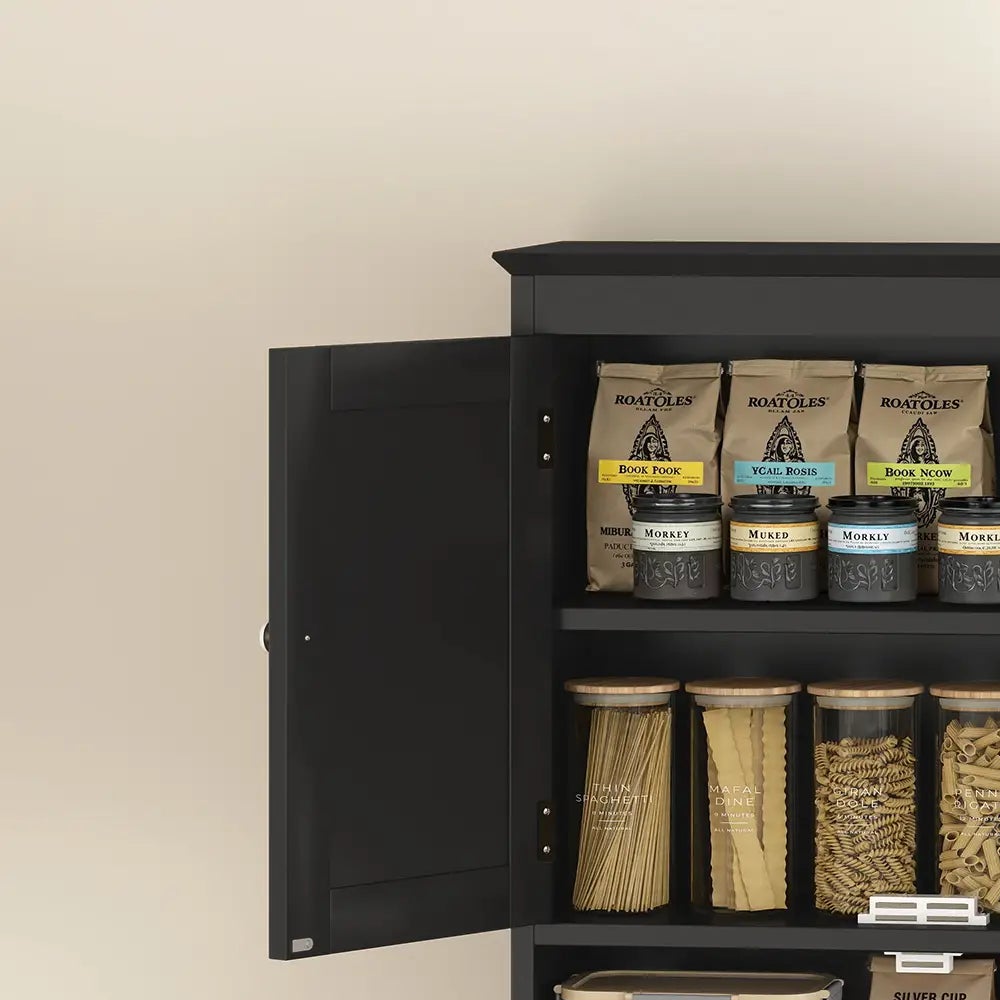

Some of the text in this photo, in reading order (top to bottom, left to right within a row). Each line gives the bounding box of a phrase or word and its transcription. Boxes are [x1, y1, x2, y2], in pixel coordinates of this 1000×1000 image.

[615, 394, 693, 407] ROATOLES
[747, 396, 826, 408] ROATOLES
[880, 397, 960, 410] ROATOLES
[619, 464, 648, 474] BOOK
[885, 467, 915, 477] BOOK
[644, 528, 690, 538] MORKEY
[748, 529, 789, 539] MUKED
[842, 530, 890, 541] MORKLY
[592, 783, 630, 792] THIN
[709, 785, 761, 794] MAFAL
[833, 787, 882, 796] GIRAN
[575, 793, 653, 805] SPAGHETTI
[715, 797, 754, 806] DINE
[836, 799, 878, 808] DOLE
